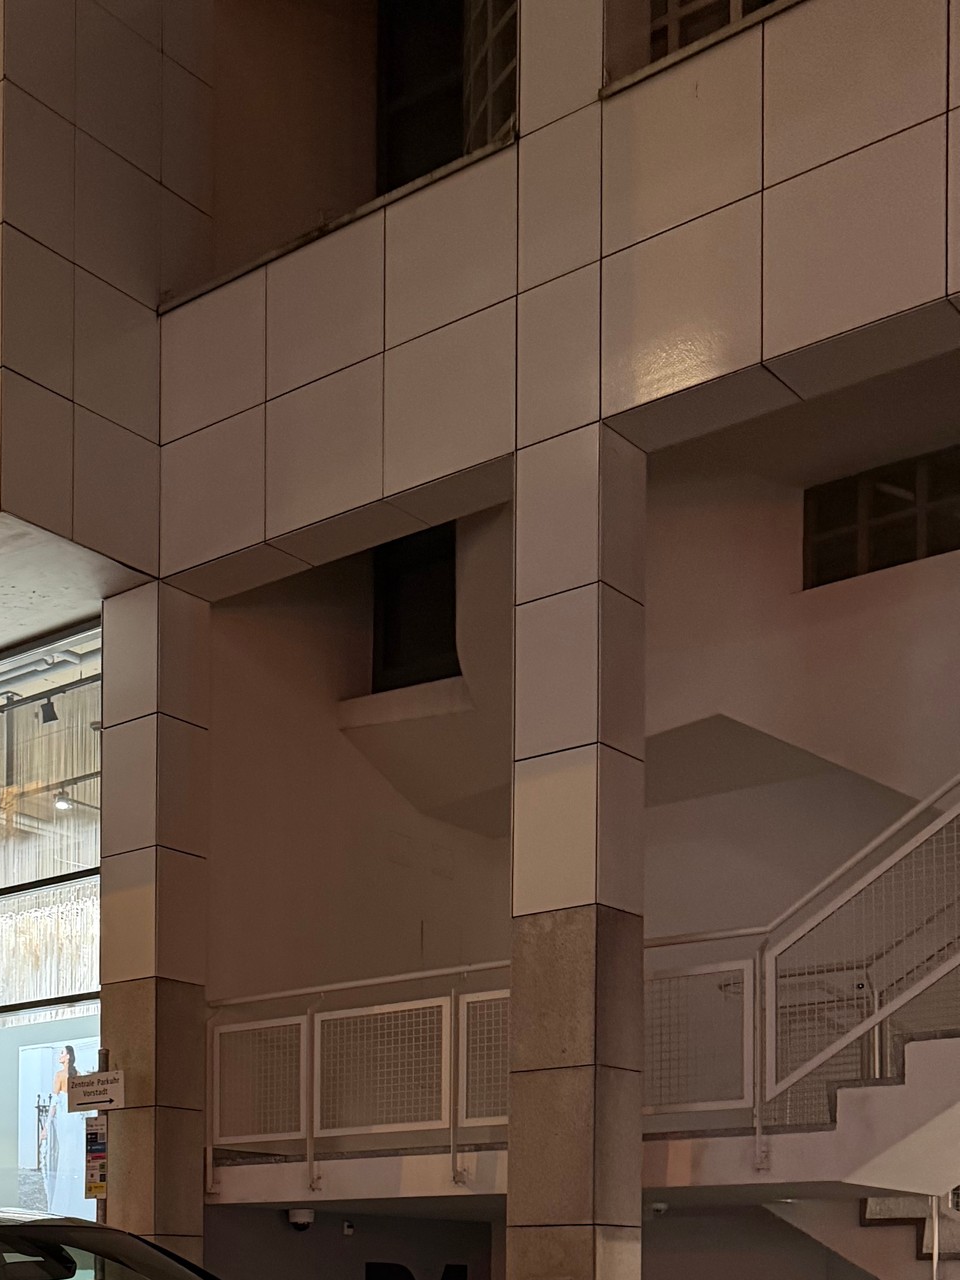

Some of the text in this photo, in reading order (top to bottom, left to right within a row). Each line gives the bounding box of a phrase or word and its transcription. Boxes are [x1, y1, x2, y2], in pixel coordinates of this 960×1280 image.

[71, 1077, 120, 1089] Zentrale Parkuhr
[82, 1088, 108, 1097] Vorstadt
